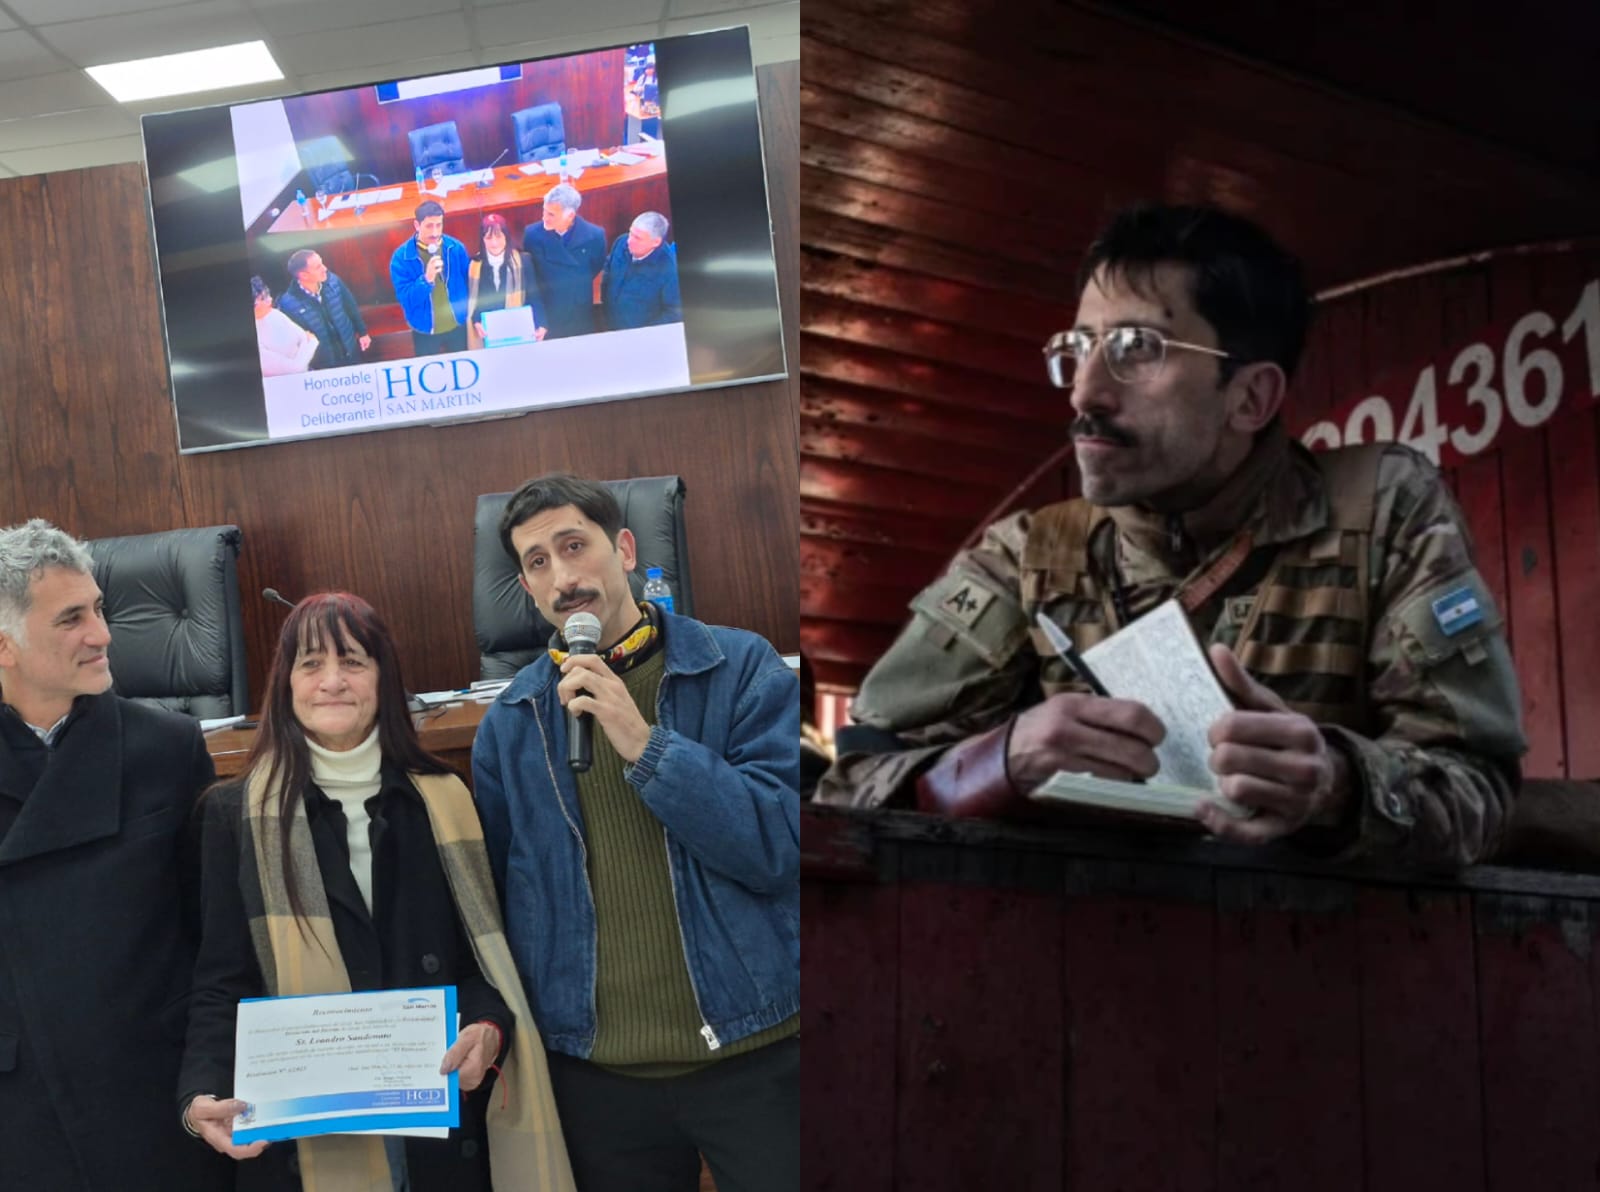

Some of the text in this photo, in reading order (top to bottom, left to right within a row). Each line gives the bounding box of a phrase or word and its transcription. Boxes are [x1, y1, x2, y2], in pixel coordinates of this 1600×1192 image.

[304, 371, 372, 391] Honorable
[382, 358, 480, 399] HCD
[321, 390, 374, 407] Concejo
[387, 400, 417, 416] SAN
[301, 408, 376, 428] Deliberante
[946, 587, 978, 613] A+
[406, 1090, 441, 1101] HCD
